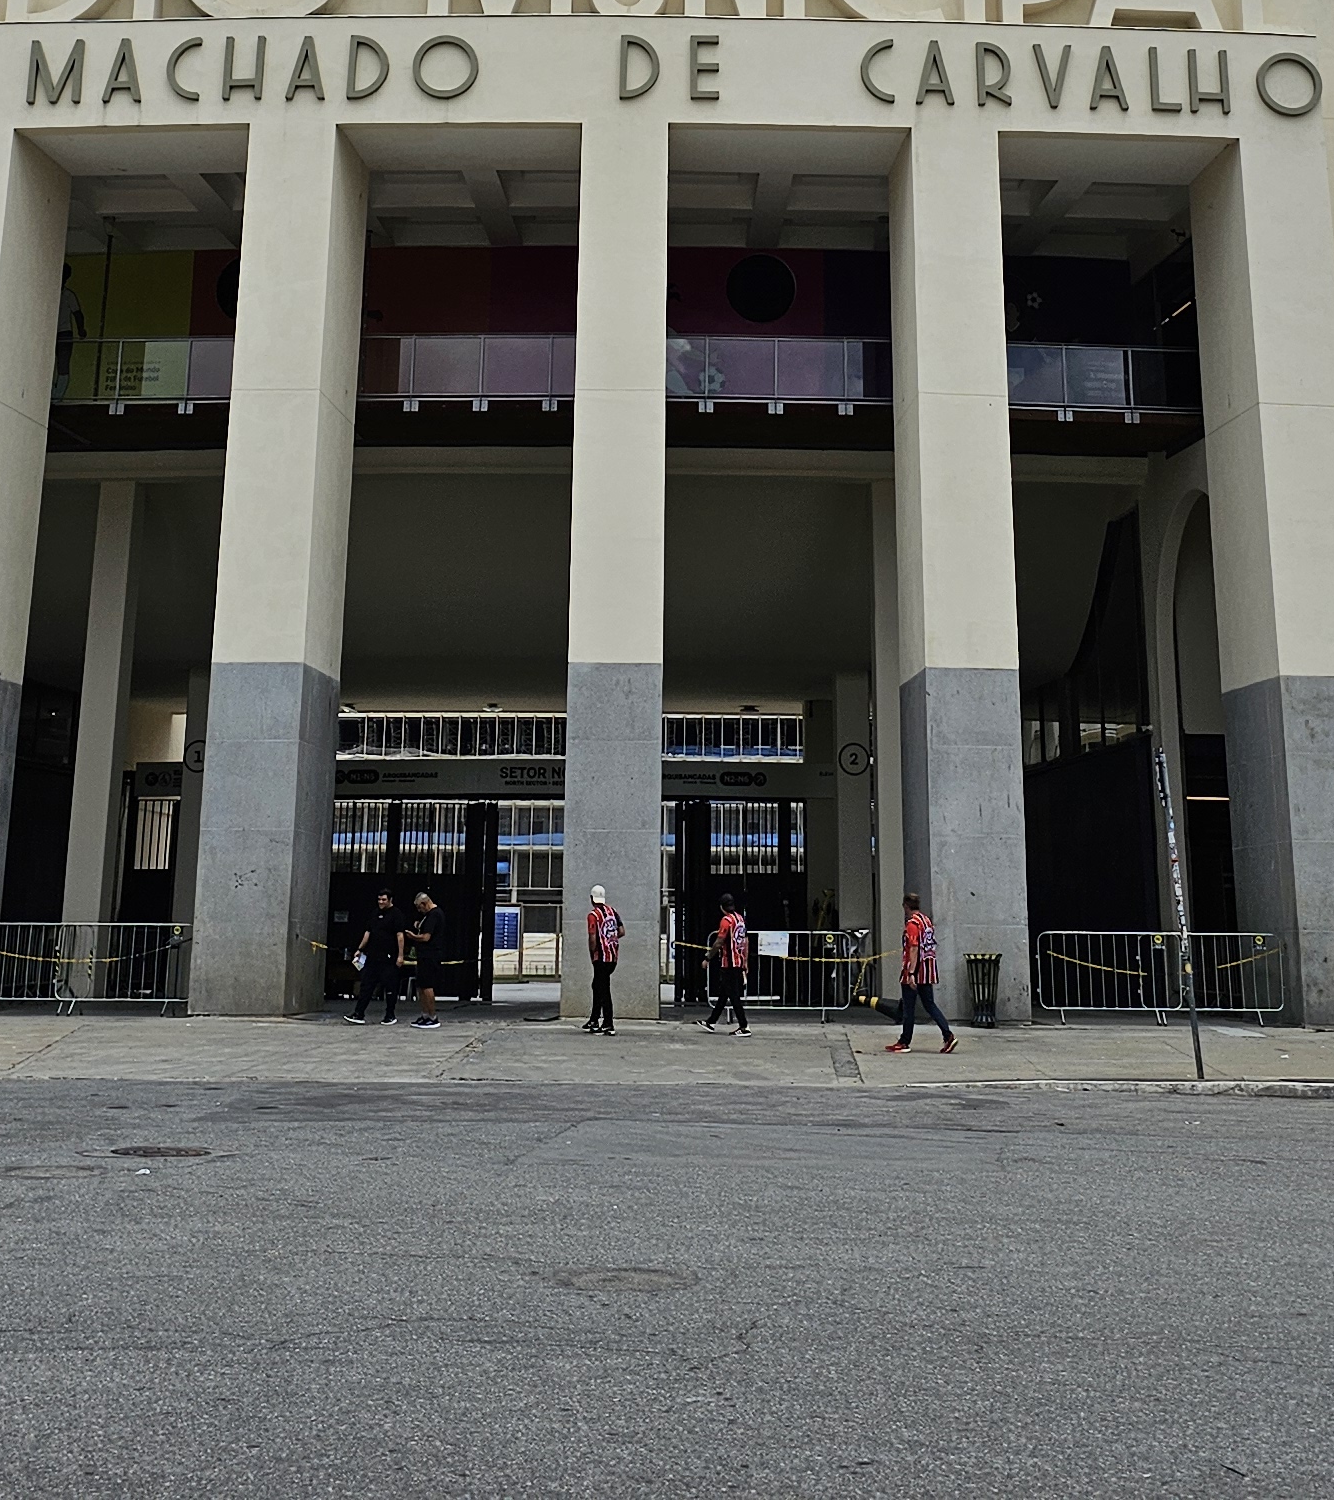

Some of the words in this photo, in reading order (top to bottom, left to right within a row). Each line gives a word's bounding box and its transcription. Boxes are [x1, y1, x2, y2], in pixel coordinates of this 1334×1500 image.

[25, 33, 479, 106] MACHADO
[619, 33, 721, 103] DE
[859, 37, 1324, 117] CARVALHO
[193, 750, 203, 763] 1
[849, 752, 859, 766] 2
[499, 766, 547, 779] SETOR
